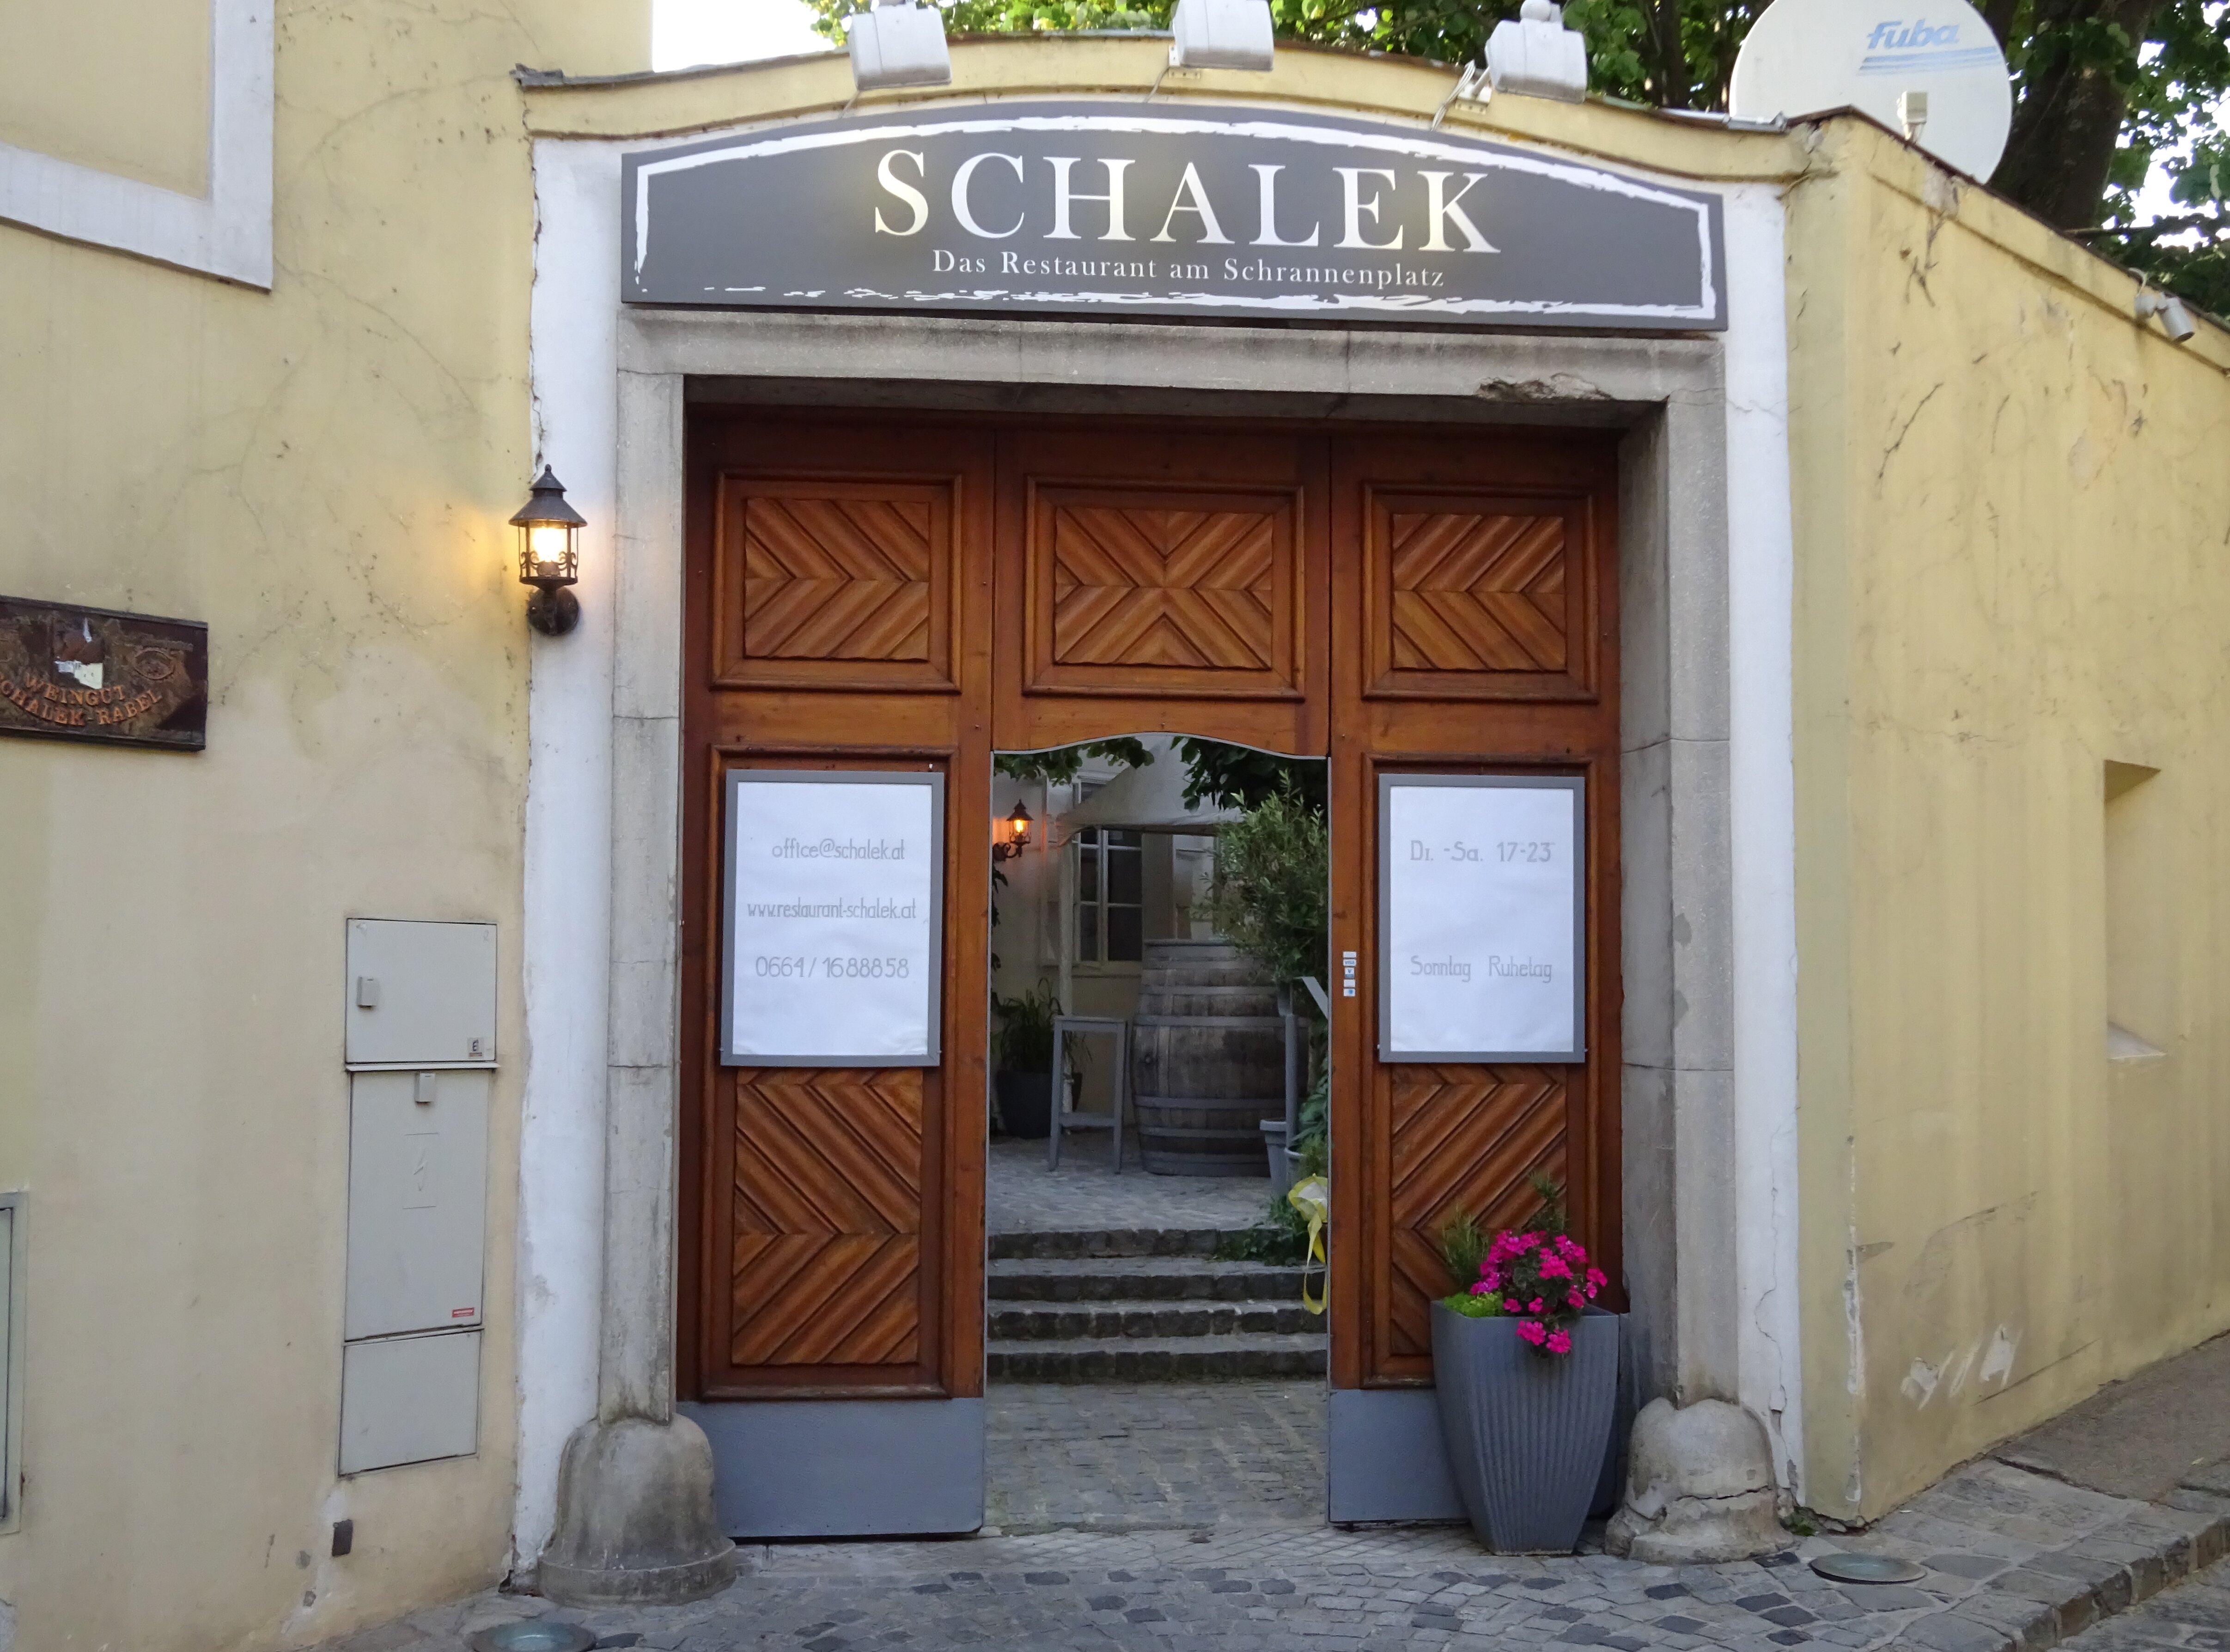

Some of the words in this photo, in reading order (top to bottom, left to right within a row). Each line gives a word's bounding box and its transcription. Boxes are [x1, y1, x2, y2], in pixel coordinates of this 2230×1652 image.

[873, 149, 1501, 257] SCHALEK
[932, 249, 986, 273] Das
[1001, 251, 1158, 278] Restaurant
[1170, 264, 1209, 279] am
[1224, 258, 1444, 290] Schrannenplatz
[25, 674, 126, 705] WEINGUT
[771, 838, 906, 861] office@schalek.at
[1496, 841, 1555, 862] 17-23
[747, 897, 917, 919] www.restaurant-schalek.at
[1410, 954, 1471, 983] Sonntag
[1489, 955, 1553, 984] Ruhetag
